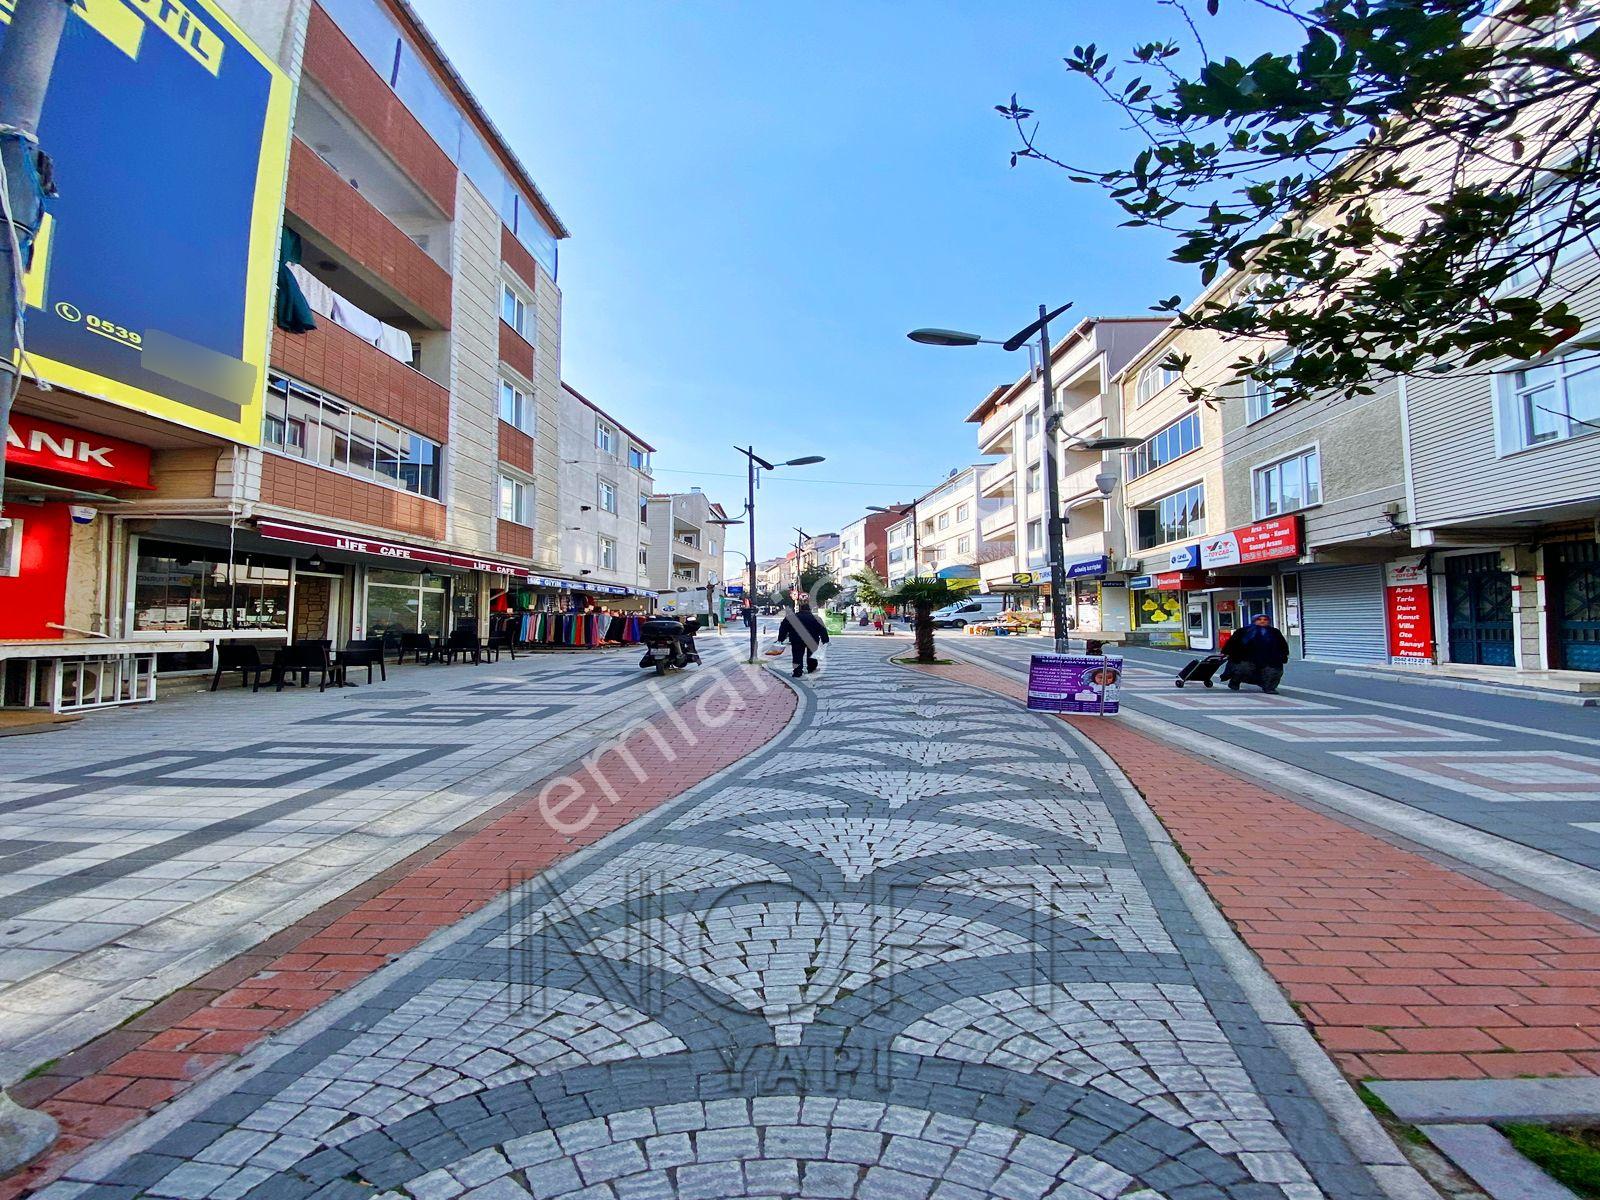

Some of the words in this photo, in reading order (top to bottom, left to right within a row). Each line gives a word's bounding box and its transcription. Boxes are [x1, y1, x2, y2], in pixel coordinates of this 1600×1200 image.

[86, 314, 142, 345] 0539
[379, 546, 410, 559] CAFE
[497, 566, 514, 575] CAFE
